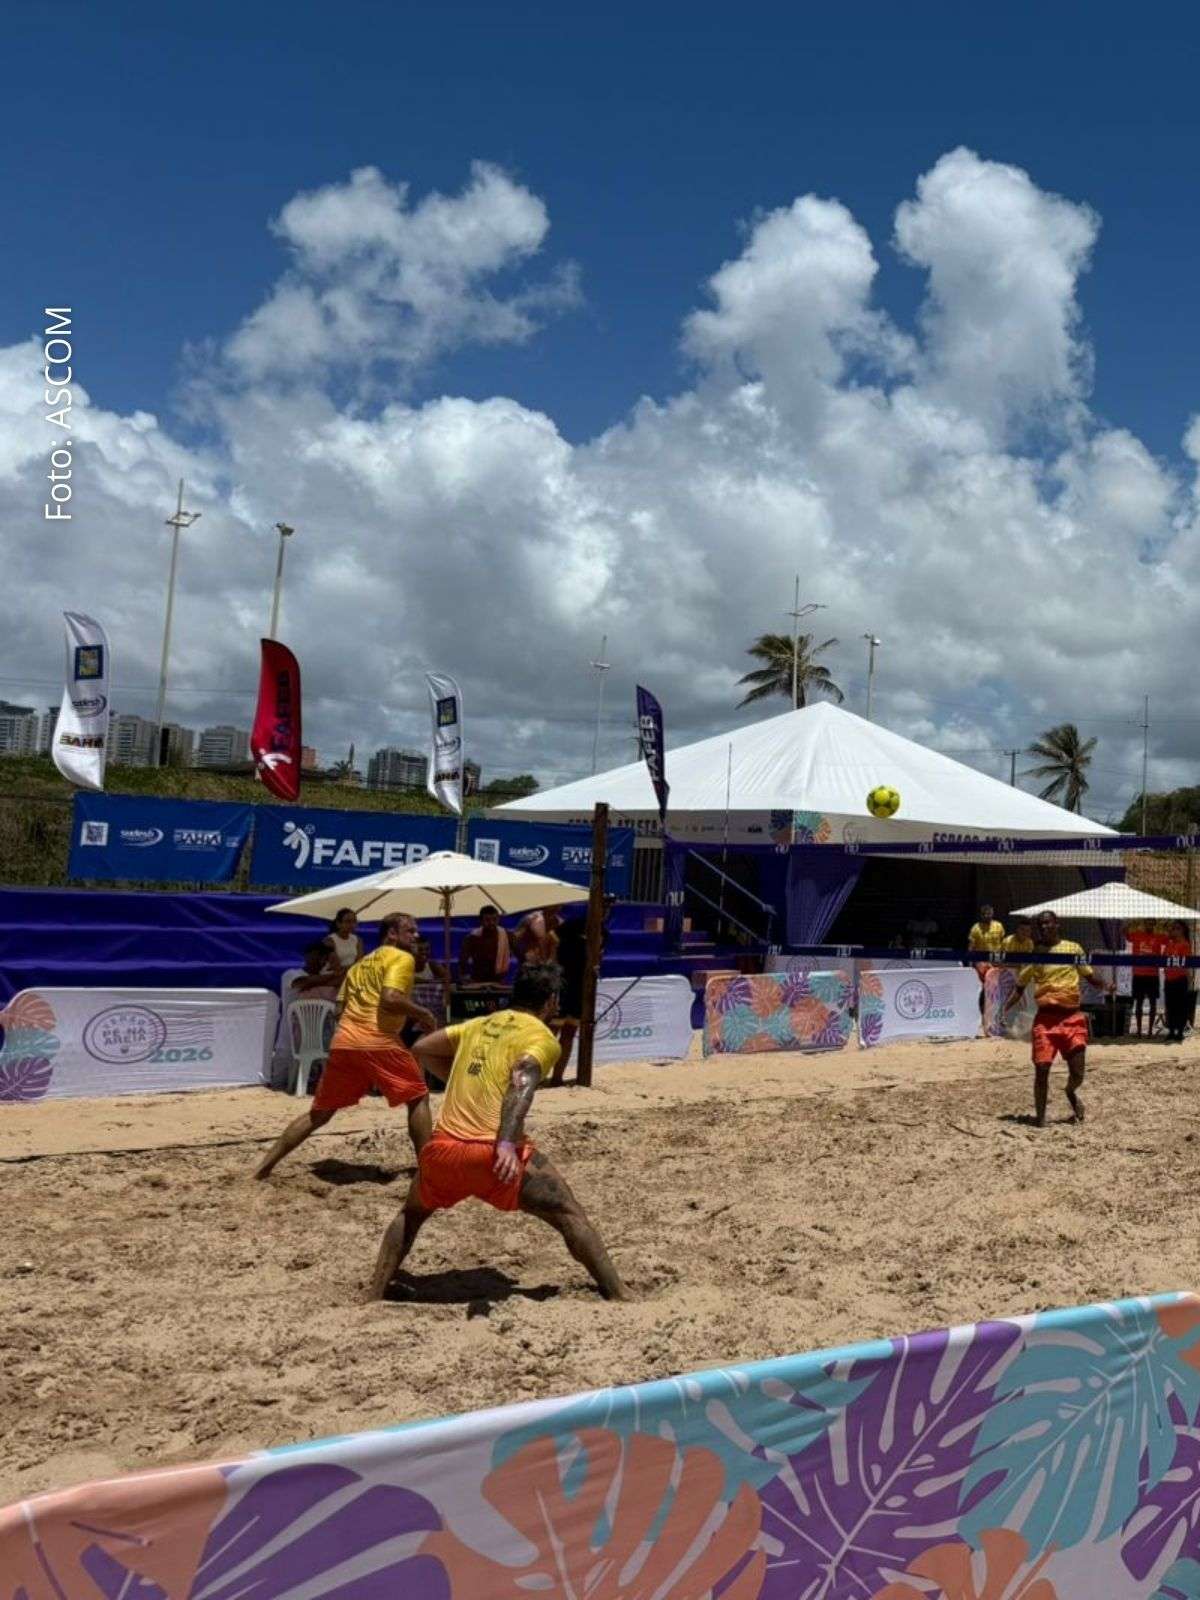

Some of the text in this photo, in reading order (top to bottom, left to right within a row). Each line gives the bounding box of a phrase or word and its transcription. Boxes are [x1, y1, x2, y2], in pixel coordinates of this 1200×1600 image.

[313, 838, 430, 868] FAFEB
[609, 1025, 653, 1040] 2026
[149, 1046, 213, 1063] 2026
